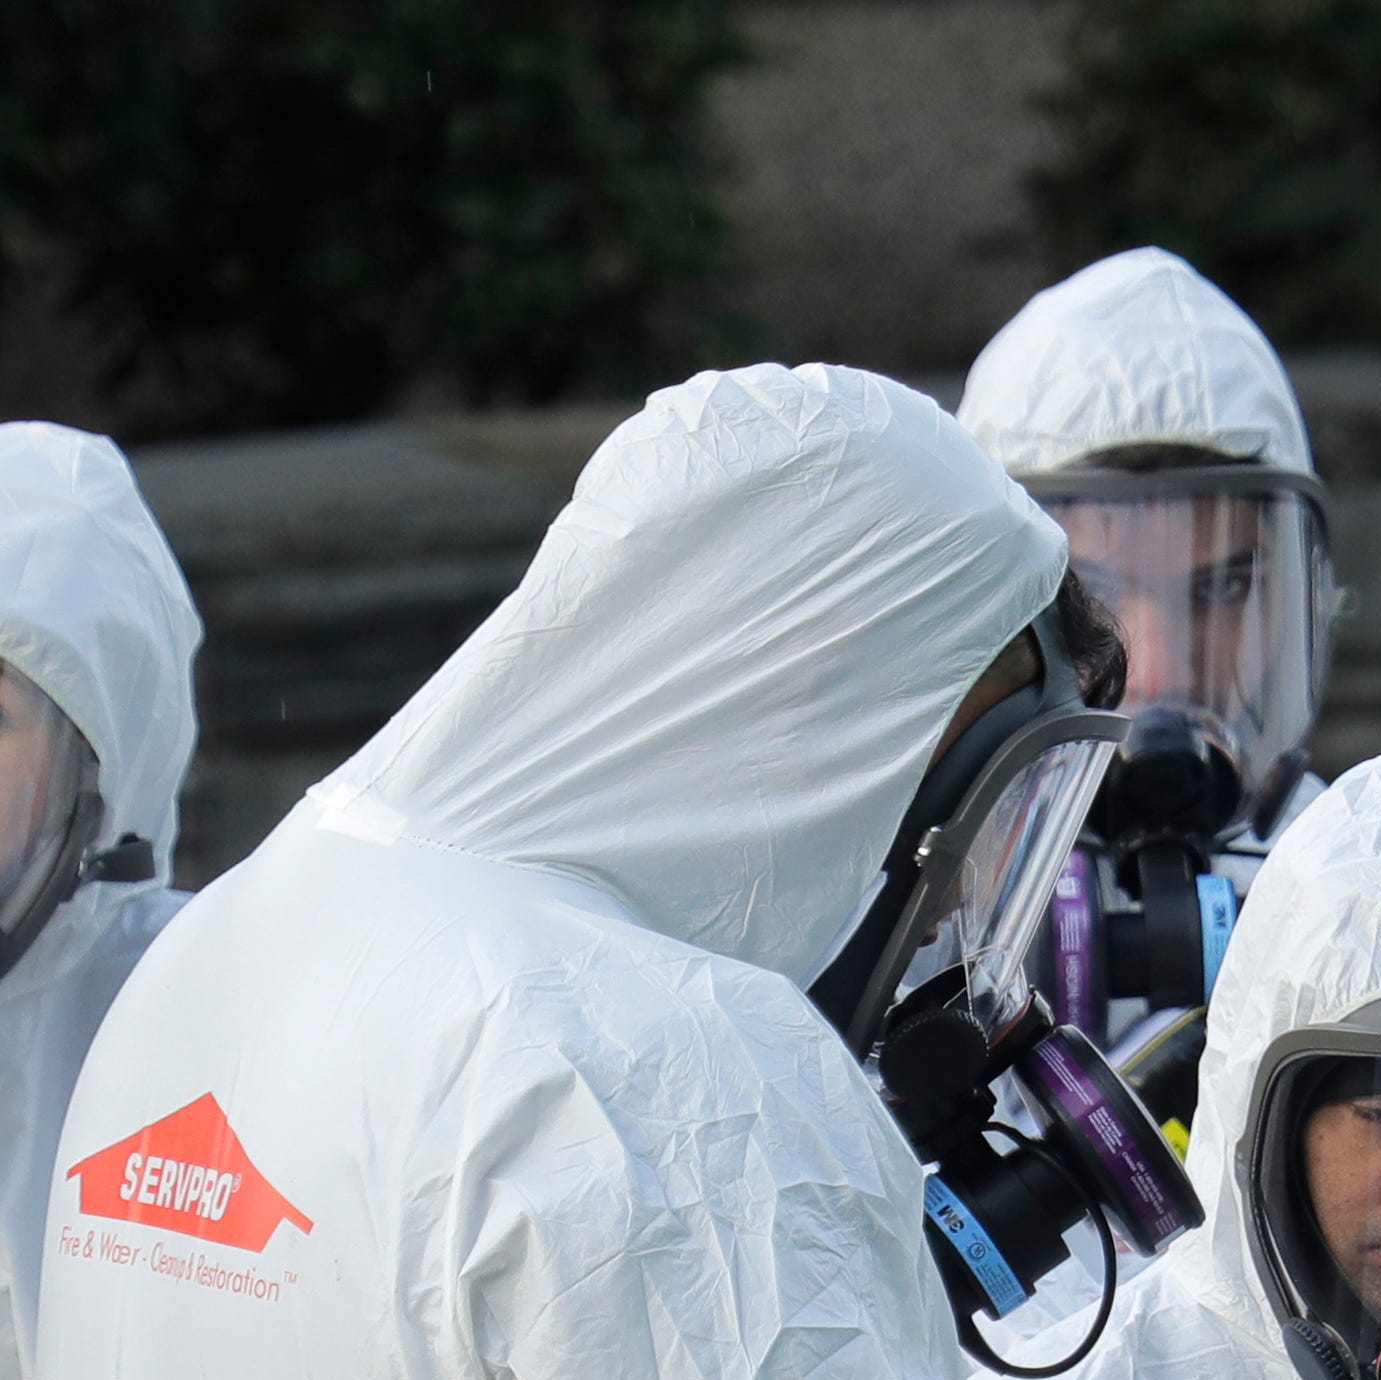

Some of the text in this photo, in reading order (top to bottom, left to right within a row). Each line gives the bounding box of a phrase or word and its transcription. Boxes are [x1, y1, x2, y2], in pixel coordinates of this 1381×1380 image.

[936, 1204, 965, 1234] 3M
[59, 1226, 80, 1256] Fire
[83, 1230, 95, 1258] &
